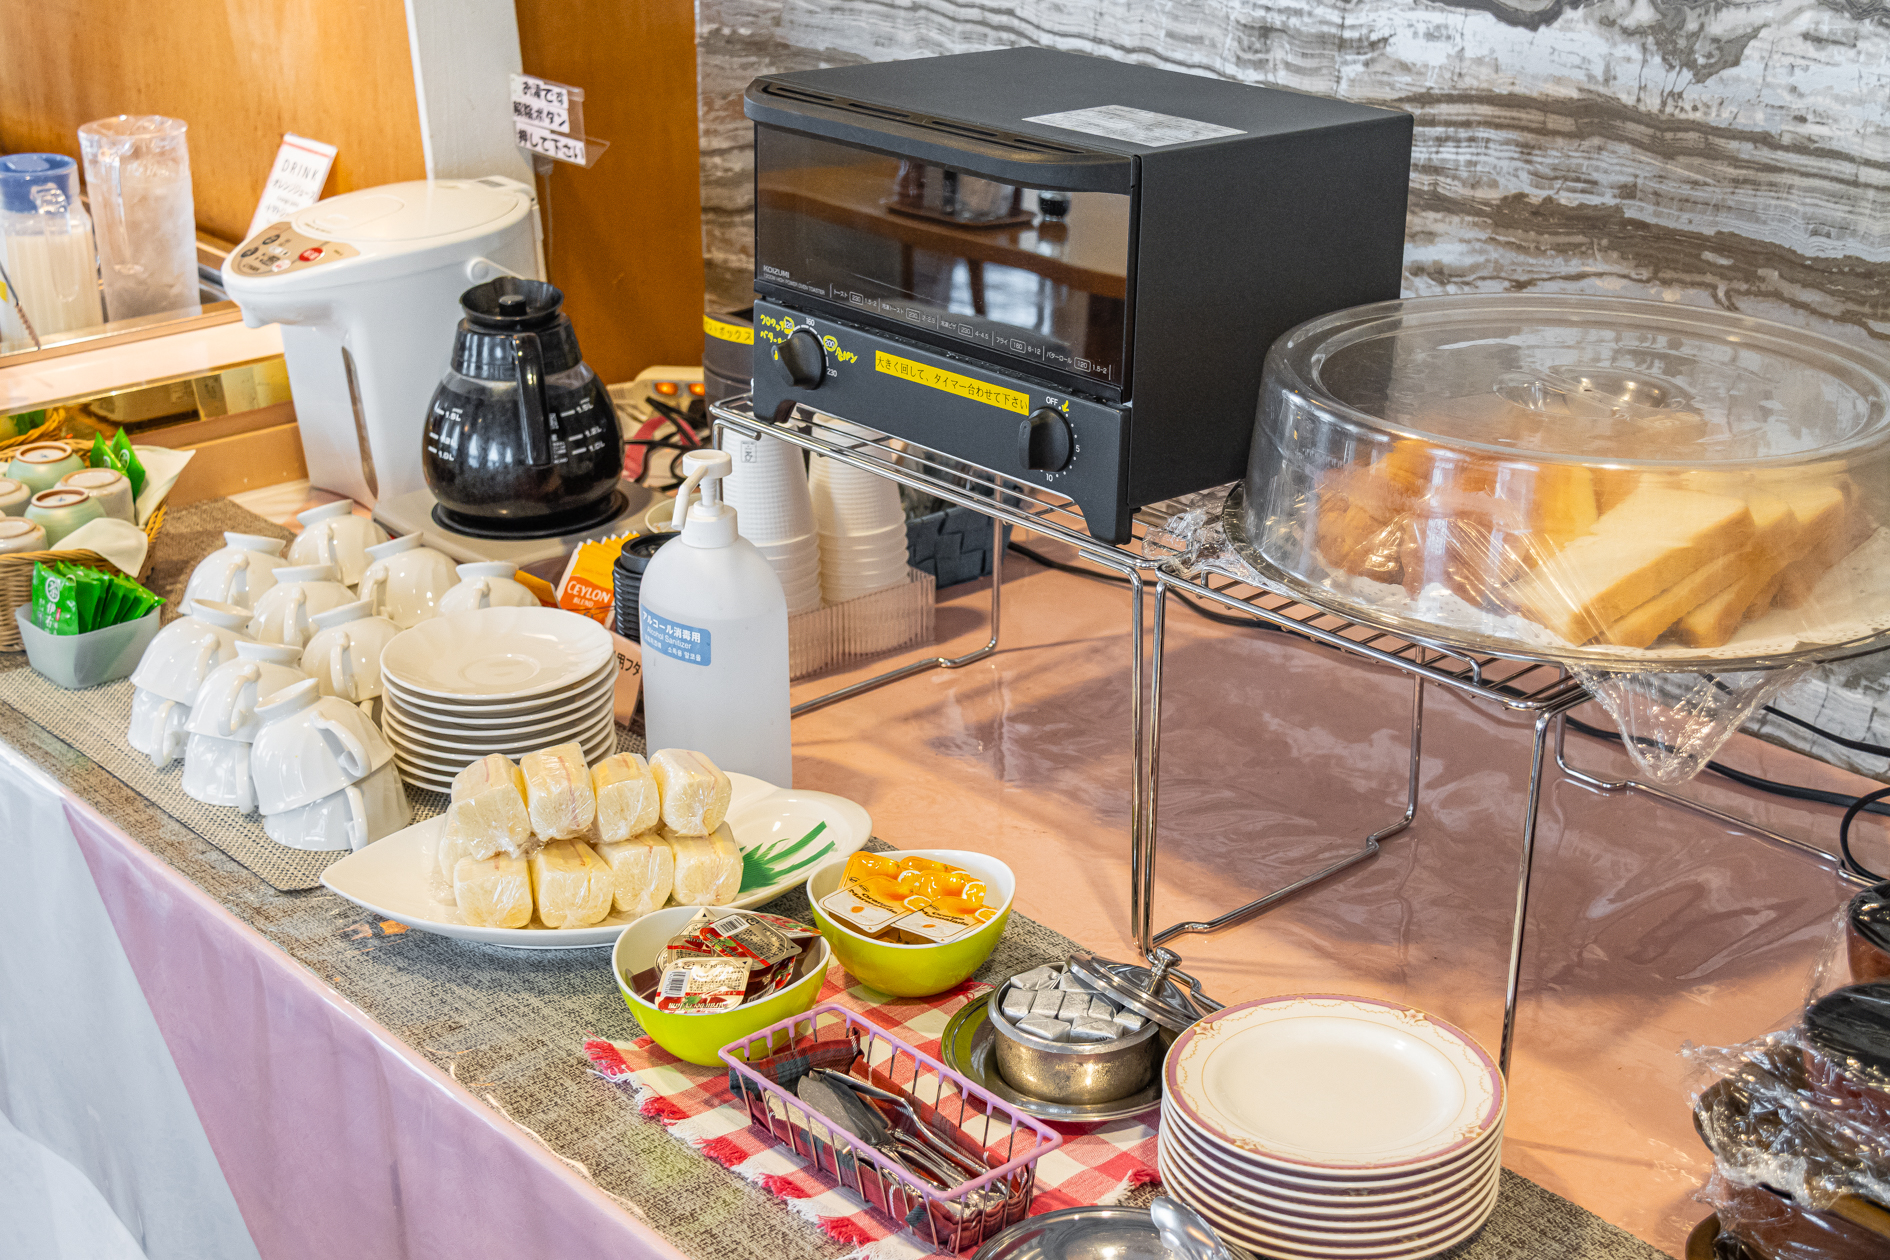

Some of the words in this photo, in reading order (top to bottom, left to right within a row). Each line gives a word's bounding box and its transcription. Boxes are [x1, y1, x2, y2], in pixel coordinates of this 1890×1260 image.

[518, 130, 585, 159] 押して下さい
[281, 159, 319, 181] DRINK
[763, 265, 790, 279] KOIZUMI
[805, 317, 816, 327] 160
[824, 338, 836, 348] 200
[995, 336, 1008, 346] フライ
[1046, 351, 1073, 364] バターロール
[1077, 360, 1088, 369] 120
[826, 367, 838, 377] 230
[876, 355, 1028, 410] 大きく回して、タイマー合わせて下さい
[1045, 396, 1058, 406] OFF
[588, 440, 606, 452] 1.0L
[1075, 444, 1080, 453] 5
[438, 450, 455, 461] 1.0L
[1046, 473, 1053, 482] 10
[567, 580, 611, 604] CEYLON
[573, 596, 594, 608] BLEND
[643, 611, 701, 644] アルコール消毒用
[647, 626, 664, 640] Alcohol
[664, 634, 692, 650] Sanitizer
[613, 651, 641, 676] 用フタ
